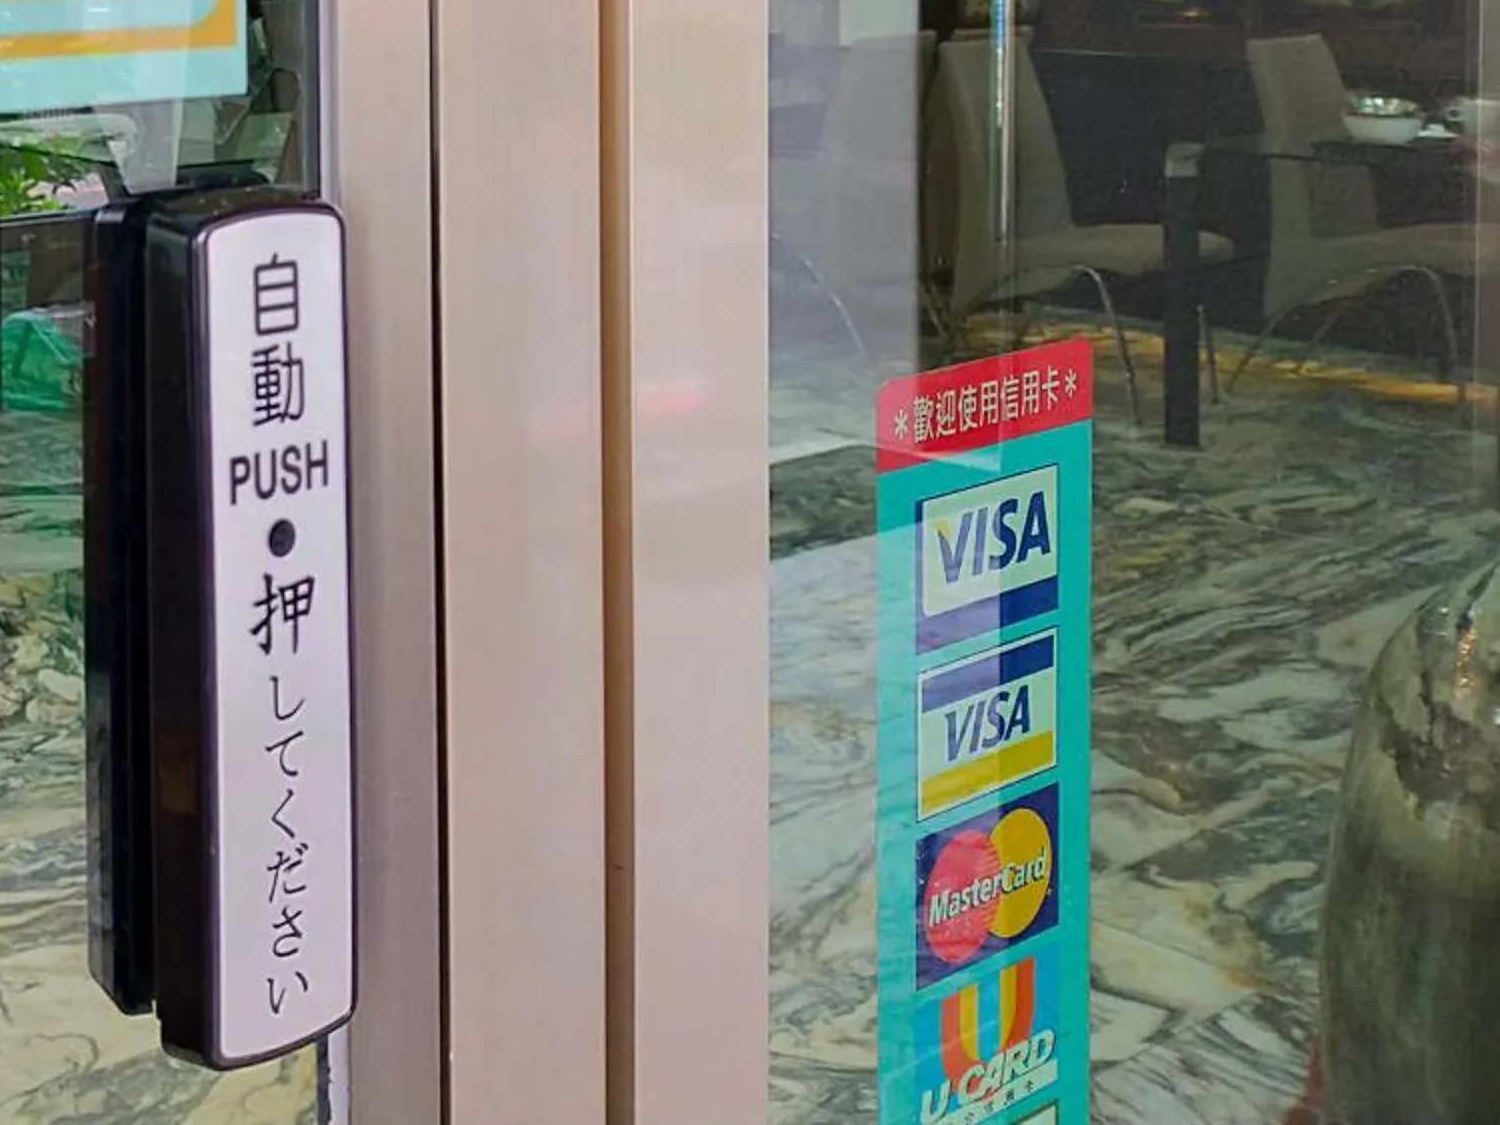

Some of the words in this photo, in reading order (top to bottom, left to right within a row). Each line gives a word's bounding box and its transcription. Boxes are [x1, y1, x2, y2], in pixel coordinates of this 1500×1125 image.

[252, 252, 305, 427] 自動
[229, 439, 330, 506] PUSH
[936, 491, 1051, 583] VISA
[945, 684, 1031, 762] VISA
[248, 573, 315, 1017] 押してください
[929, 847, 1047, 926] MasterCard
